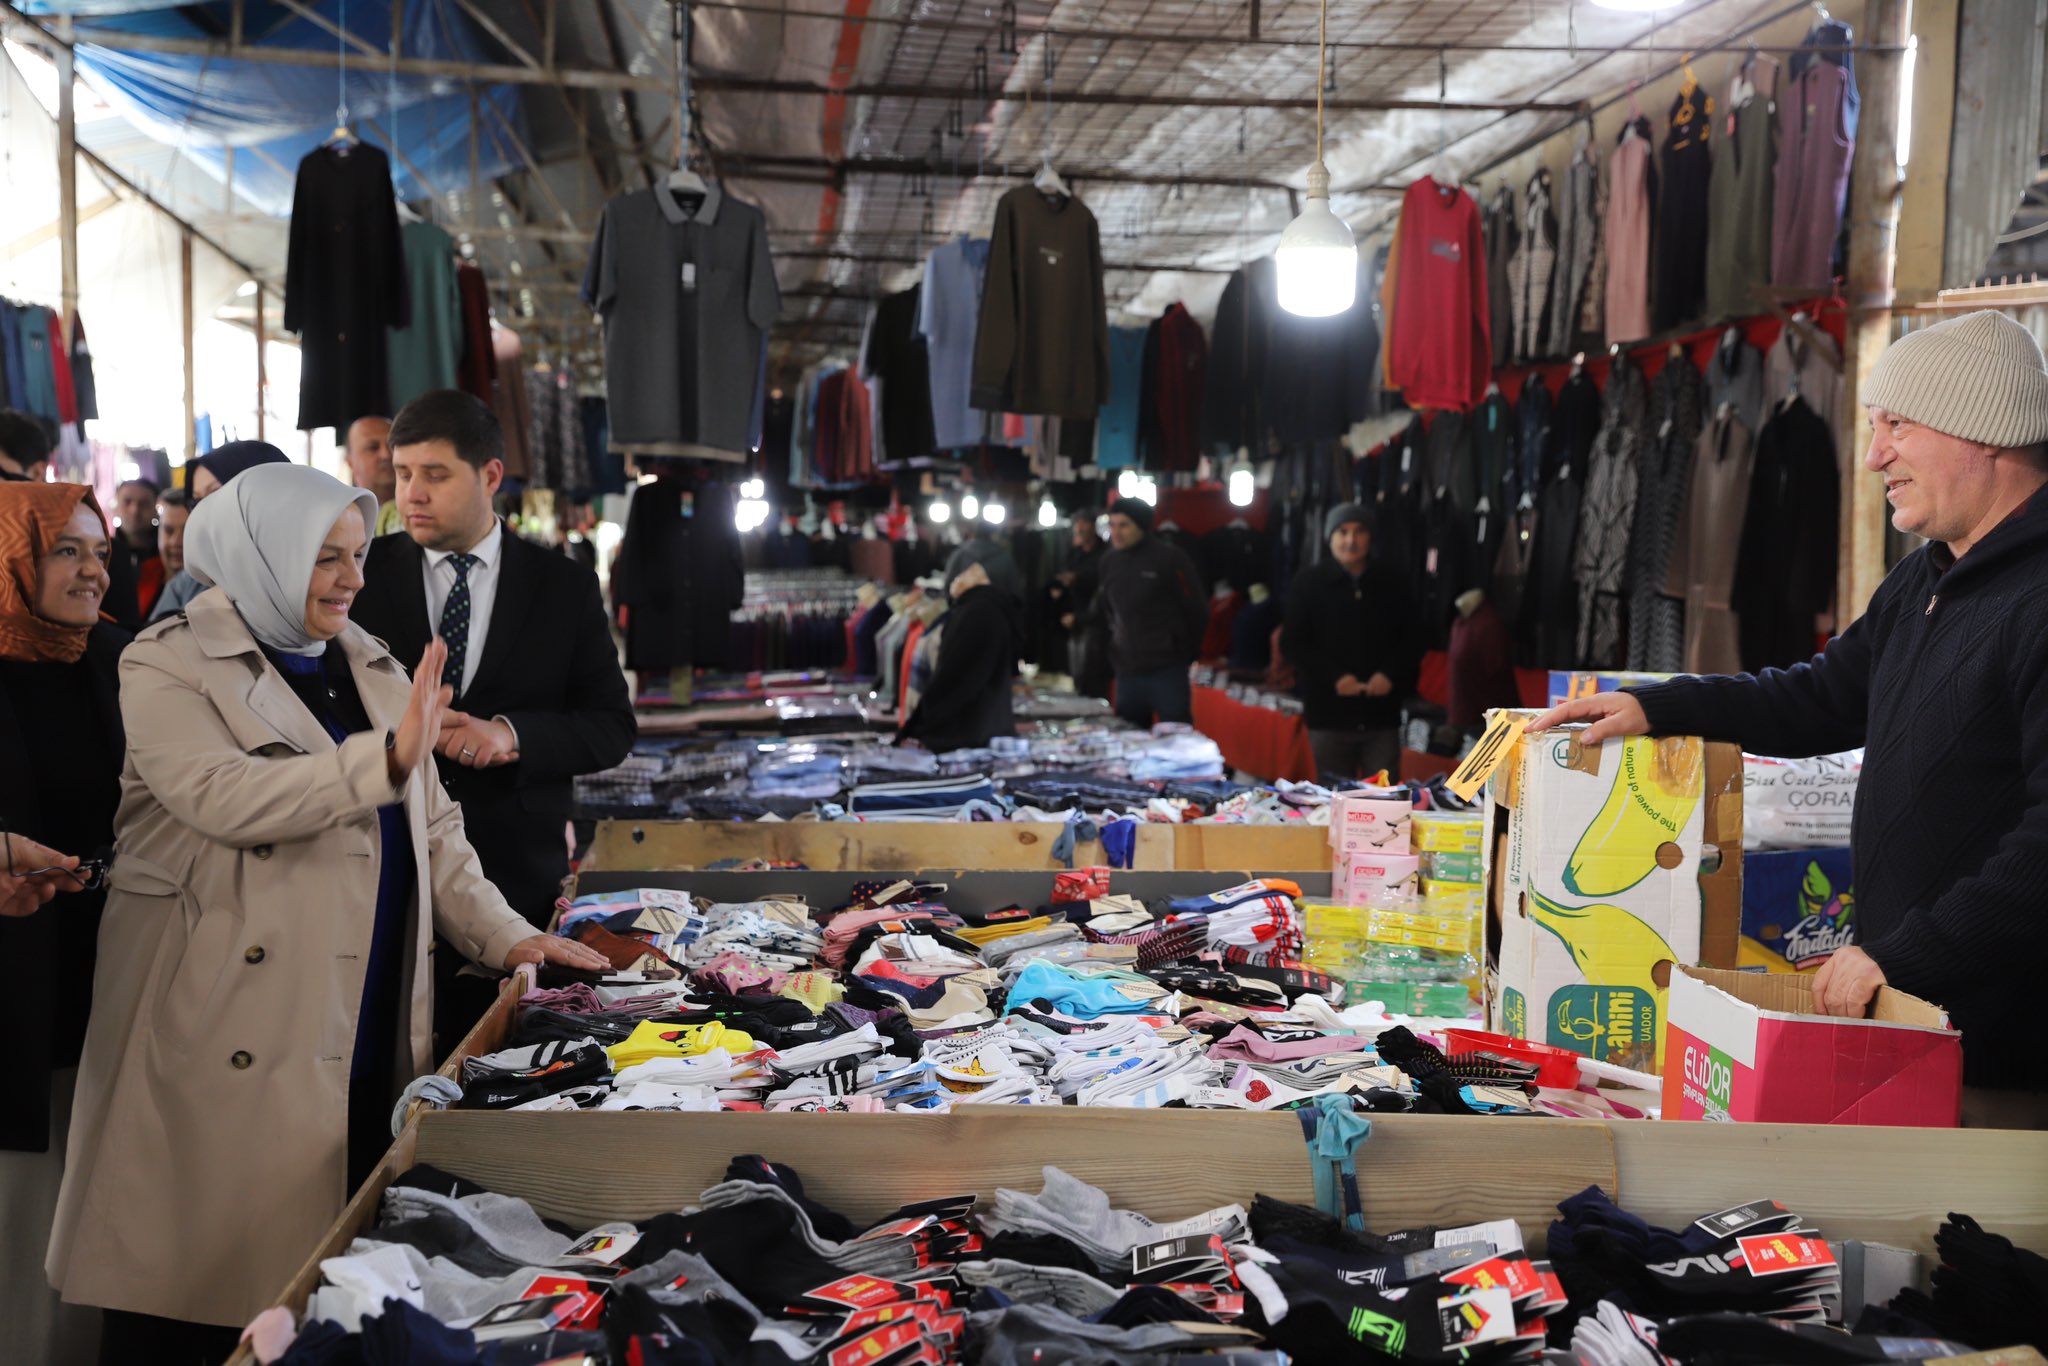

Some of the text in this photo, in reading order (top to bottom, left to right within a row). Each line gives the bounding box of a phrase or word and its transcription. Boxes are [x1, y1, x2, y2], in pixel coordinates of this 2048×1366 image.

[1626, 746, 1677, 832] The power of nature
[1516, 827, 1524, 878] HANDLE
[1386, 1232, 1408, 1243] NIKE
